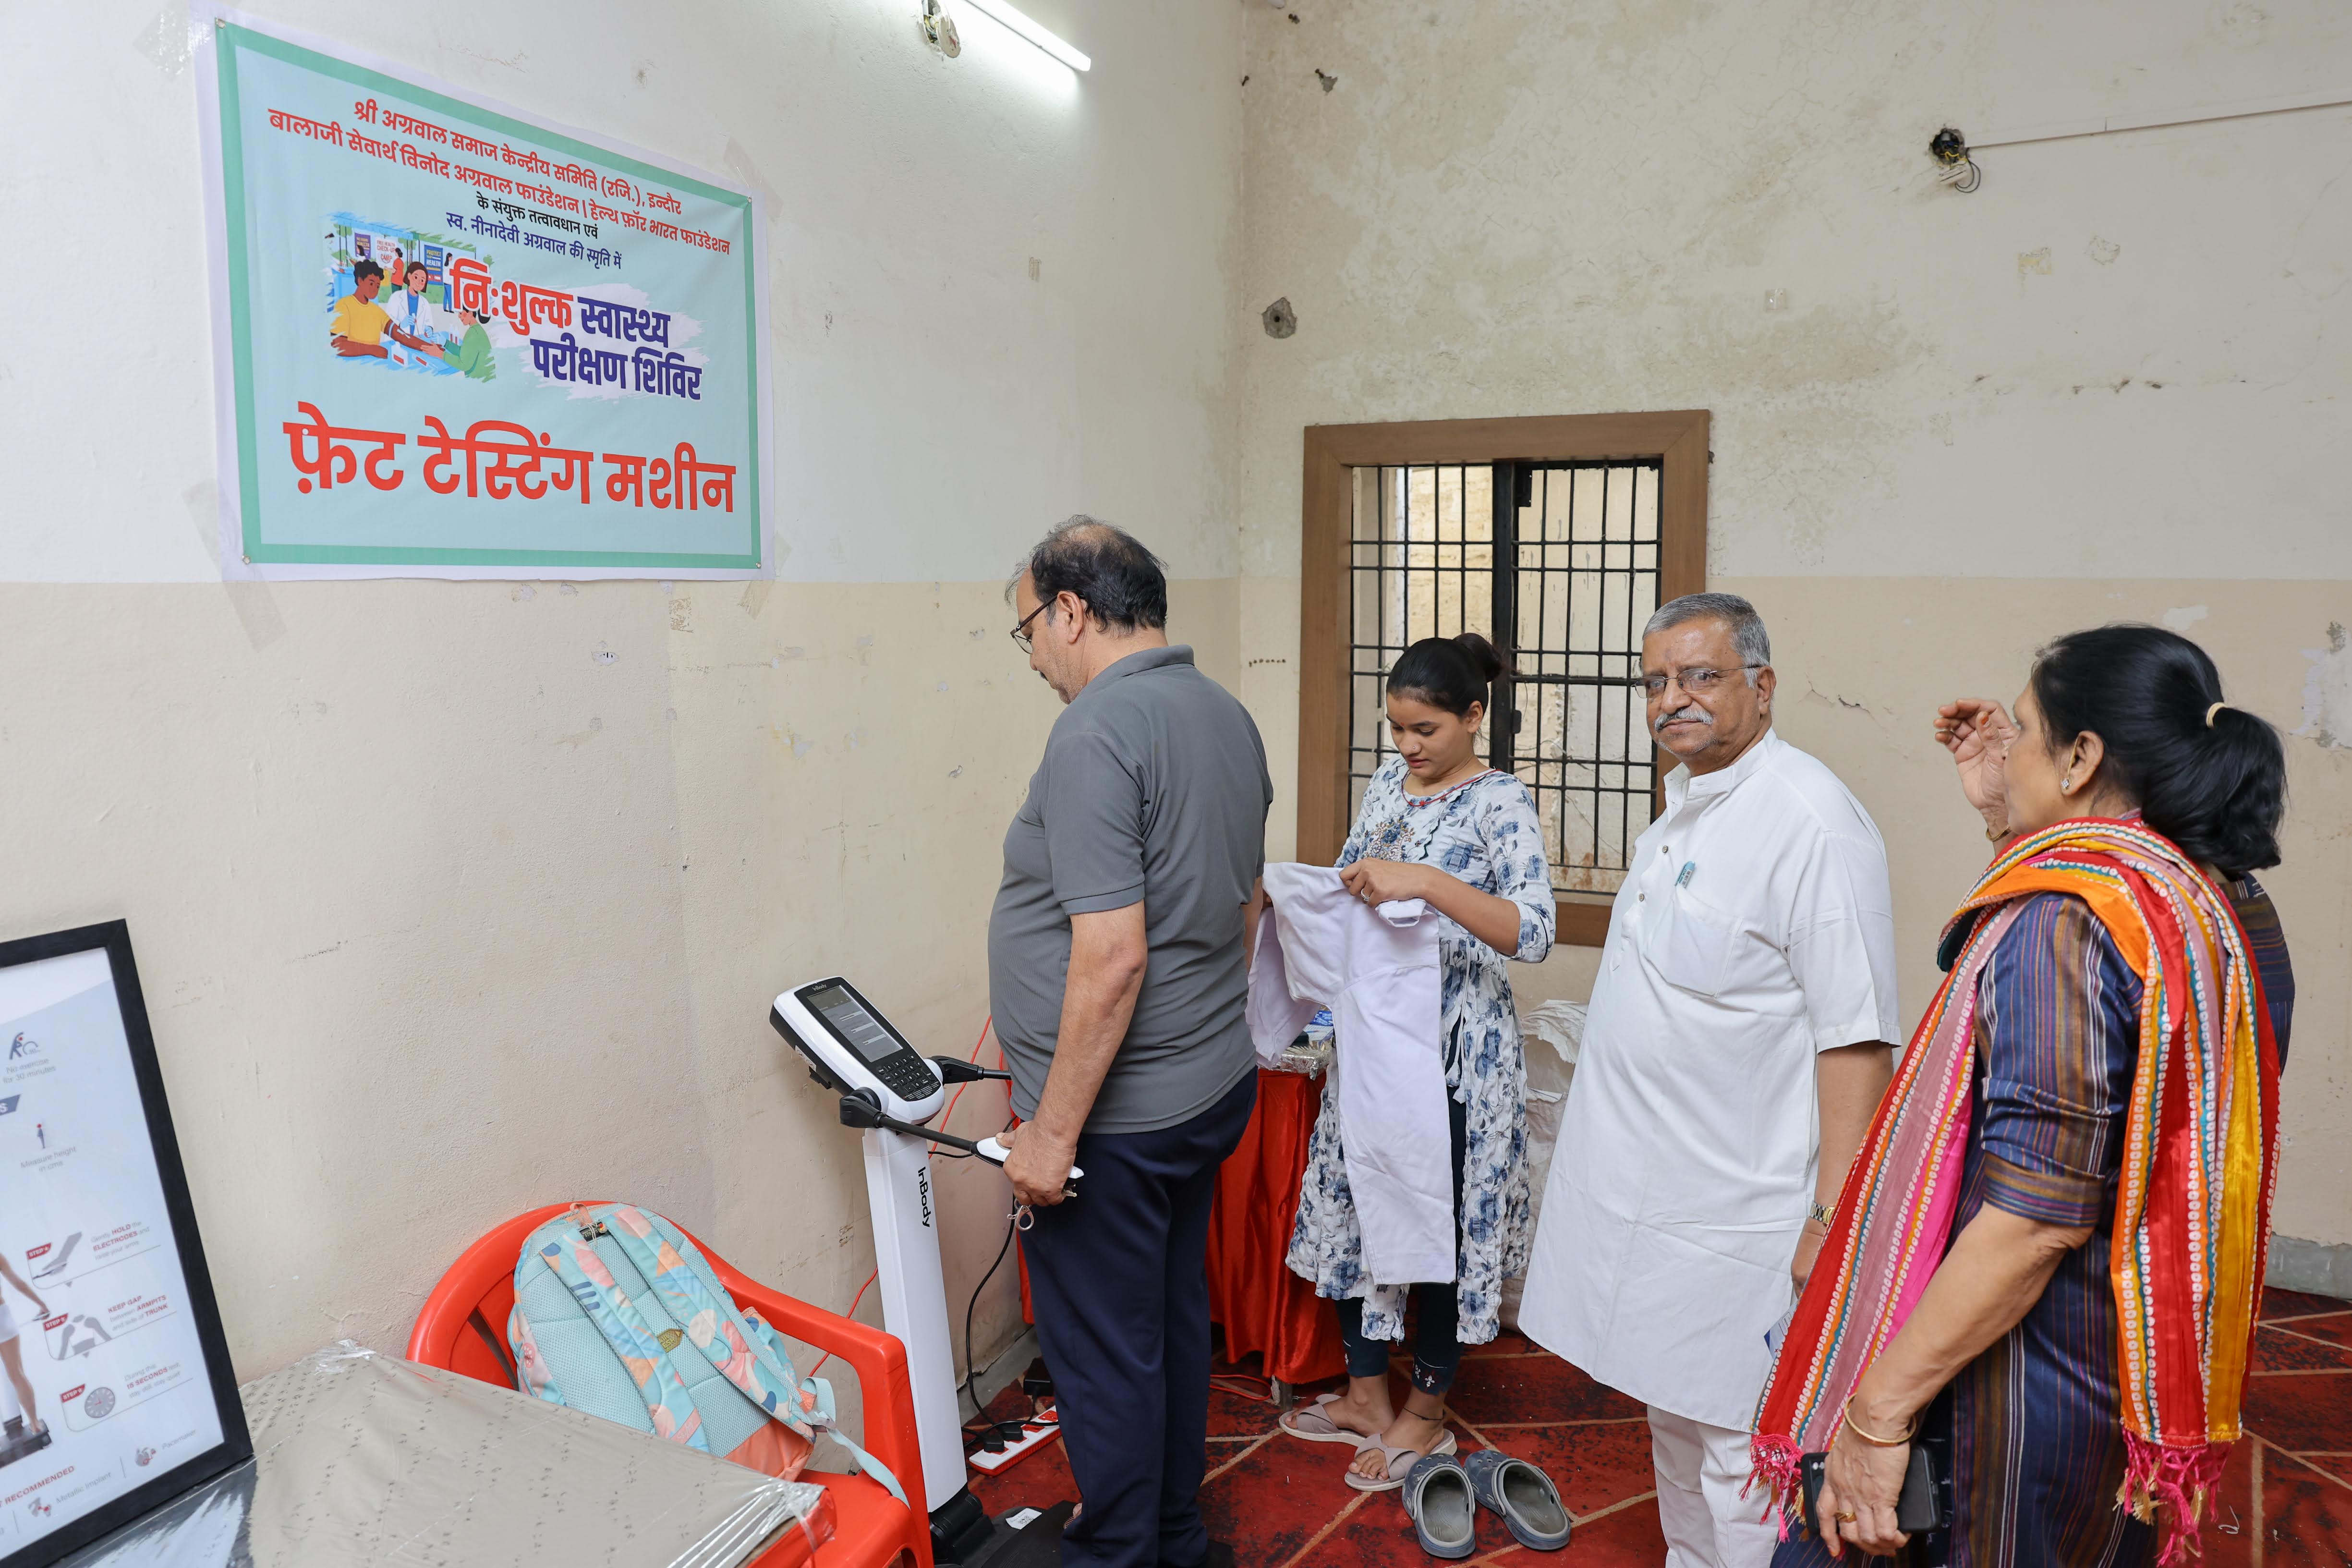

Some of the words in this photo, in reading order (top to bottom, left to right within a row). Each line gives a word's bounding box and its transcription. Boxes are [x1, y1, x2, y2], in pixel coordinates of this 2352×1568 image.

[355, 99, 377, 124] श्री
[383, 110, 447, 145] अग्रवाल
[451, 132, 497, 161] समाज
[501, 144, 550, 177] केन्द्रीय
[553, 164, 597, 191] समिति
[647, 193, 681, 215] इन्दौर
[267, 109, 342, 146] बालाजी
[346, 129, 398, 162] सेवार्थ
[400, 144, 449, 179] विनोद
[454, 165, 512, 195] अग्रवाल
[516, 183, 579, 213] फाउंडेशन
[589, 200, 618, 225] हेल्थ
[649, 219, 678, 241] भारत
[680, 227, 730, 255] फाउंडेशन
[476, 191, 489, 209] के
[492, 197, 525, 223] संयुक्त
[528, 209, 580, 235] तत्वावधान
[583, 224, 598, 239] एवं
[446, 212, 467, 231] स्व.
[471, 215, 520, 244] नीनादेवी
[524, 231, 566, 256] अग्रवाल
[569, 240, 584, 260] की
[587, 248, 611, 270] स्मृति
[577, 296, 670, 348] स्वास्थ्य
[530, 332, 628, 389] परीक्षण
[631, 347, 702, 400] शिविर
[283, 401, 406, 494] फ़ेट
[418, 415, 594, 504] टेस्टिंग
[603, 442, 736, 512] मशीन
[918, 1167, 931, 1228] InBody
[92, 1230, 138, 1252] ELECTRODES
[111, 1224, 131, 1236] HOLD
[108, 1301, 126, 1313] KEEP
[127, 1295, 142, 1305] GAP
[137, 1295, 167, 1312] ARMPITS
[145, 1303, 168, 1317] TRUNK
[135, 1367, 168, 1386] SECONDS
[5, 1466, 74, 1505] RECOMMENDED
